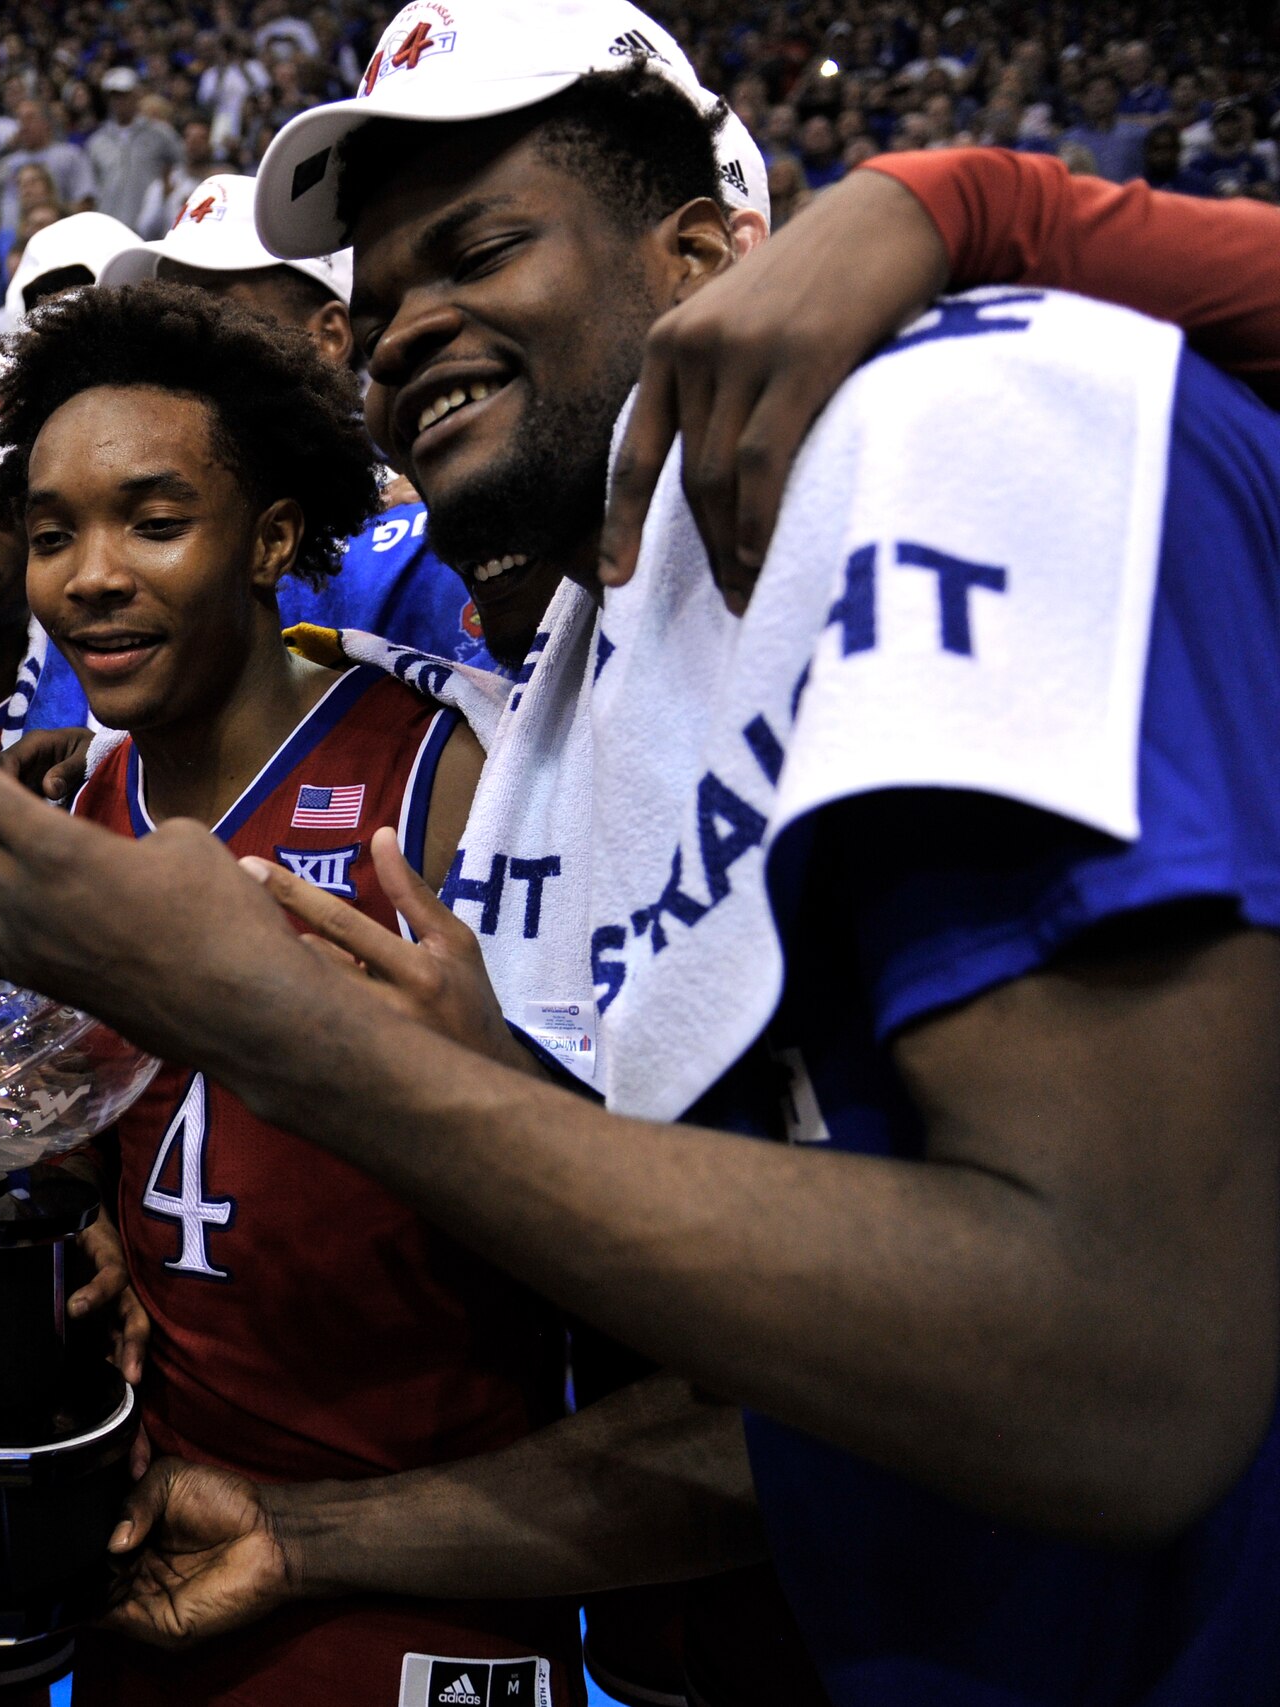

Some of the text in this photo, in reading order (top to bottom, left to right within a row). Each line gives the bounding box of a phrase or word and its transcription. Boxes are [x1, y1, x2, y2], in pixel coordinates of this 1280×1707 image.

[364, 21, 434, 97] 14
[143, 1071, 231, 1277] 4
[438, 1692, 481, 1705] adidas
[507, 1680, 520, 1696] M
